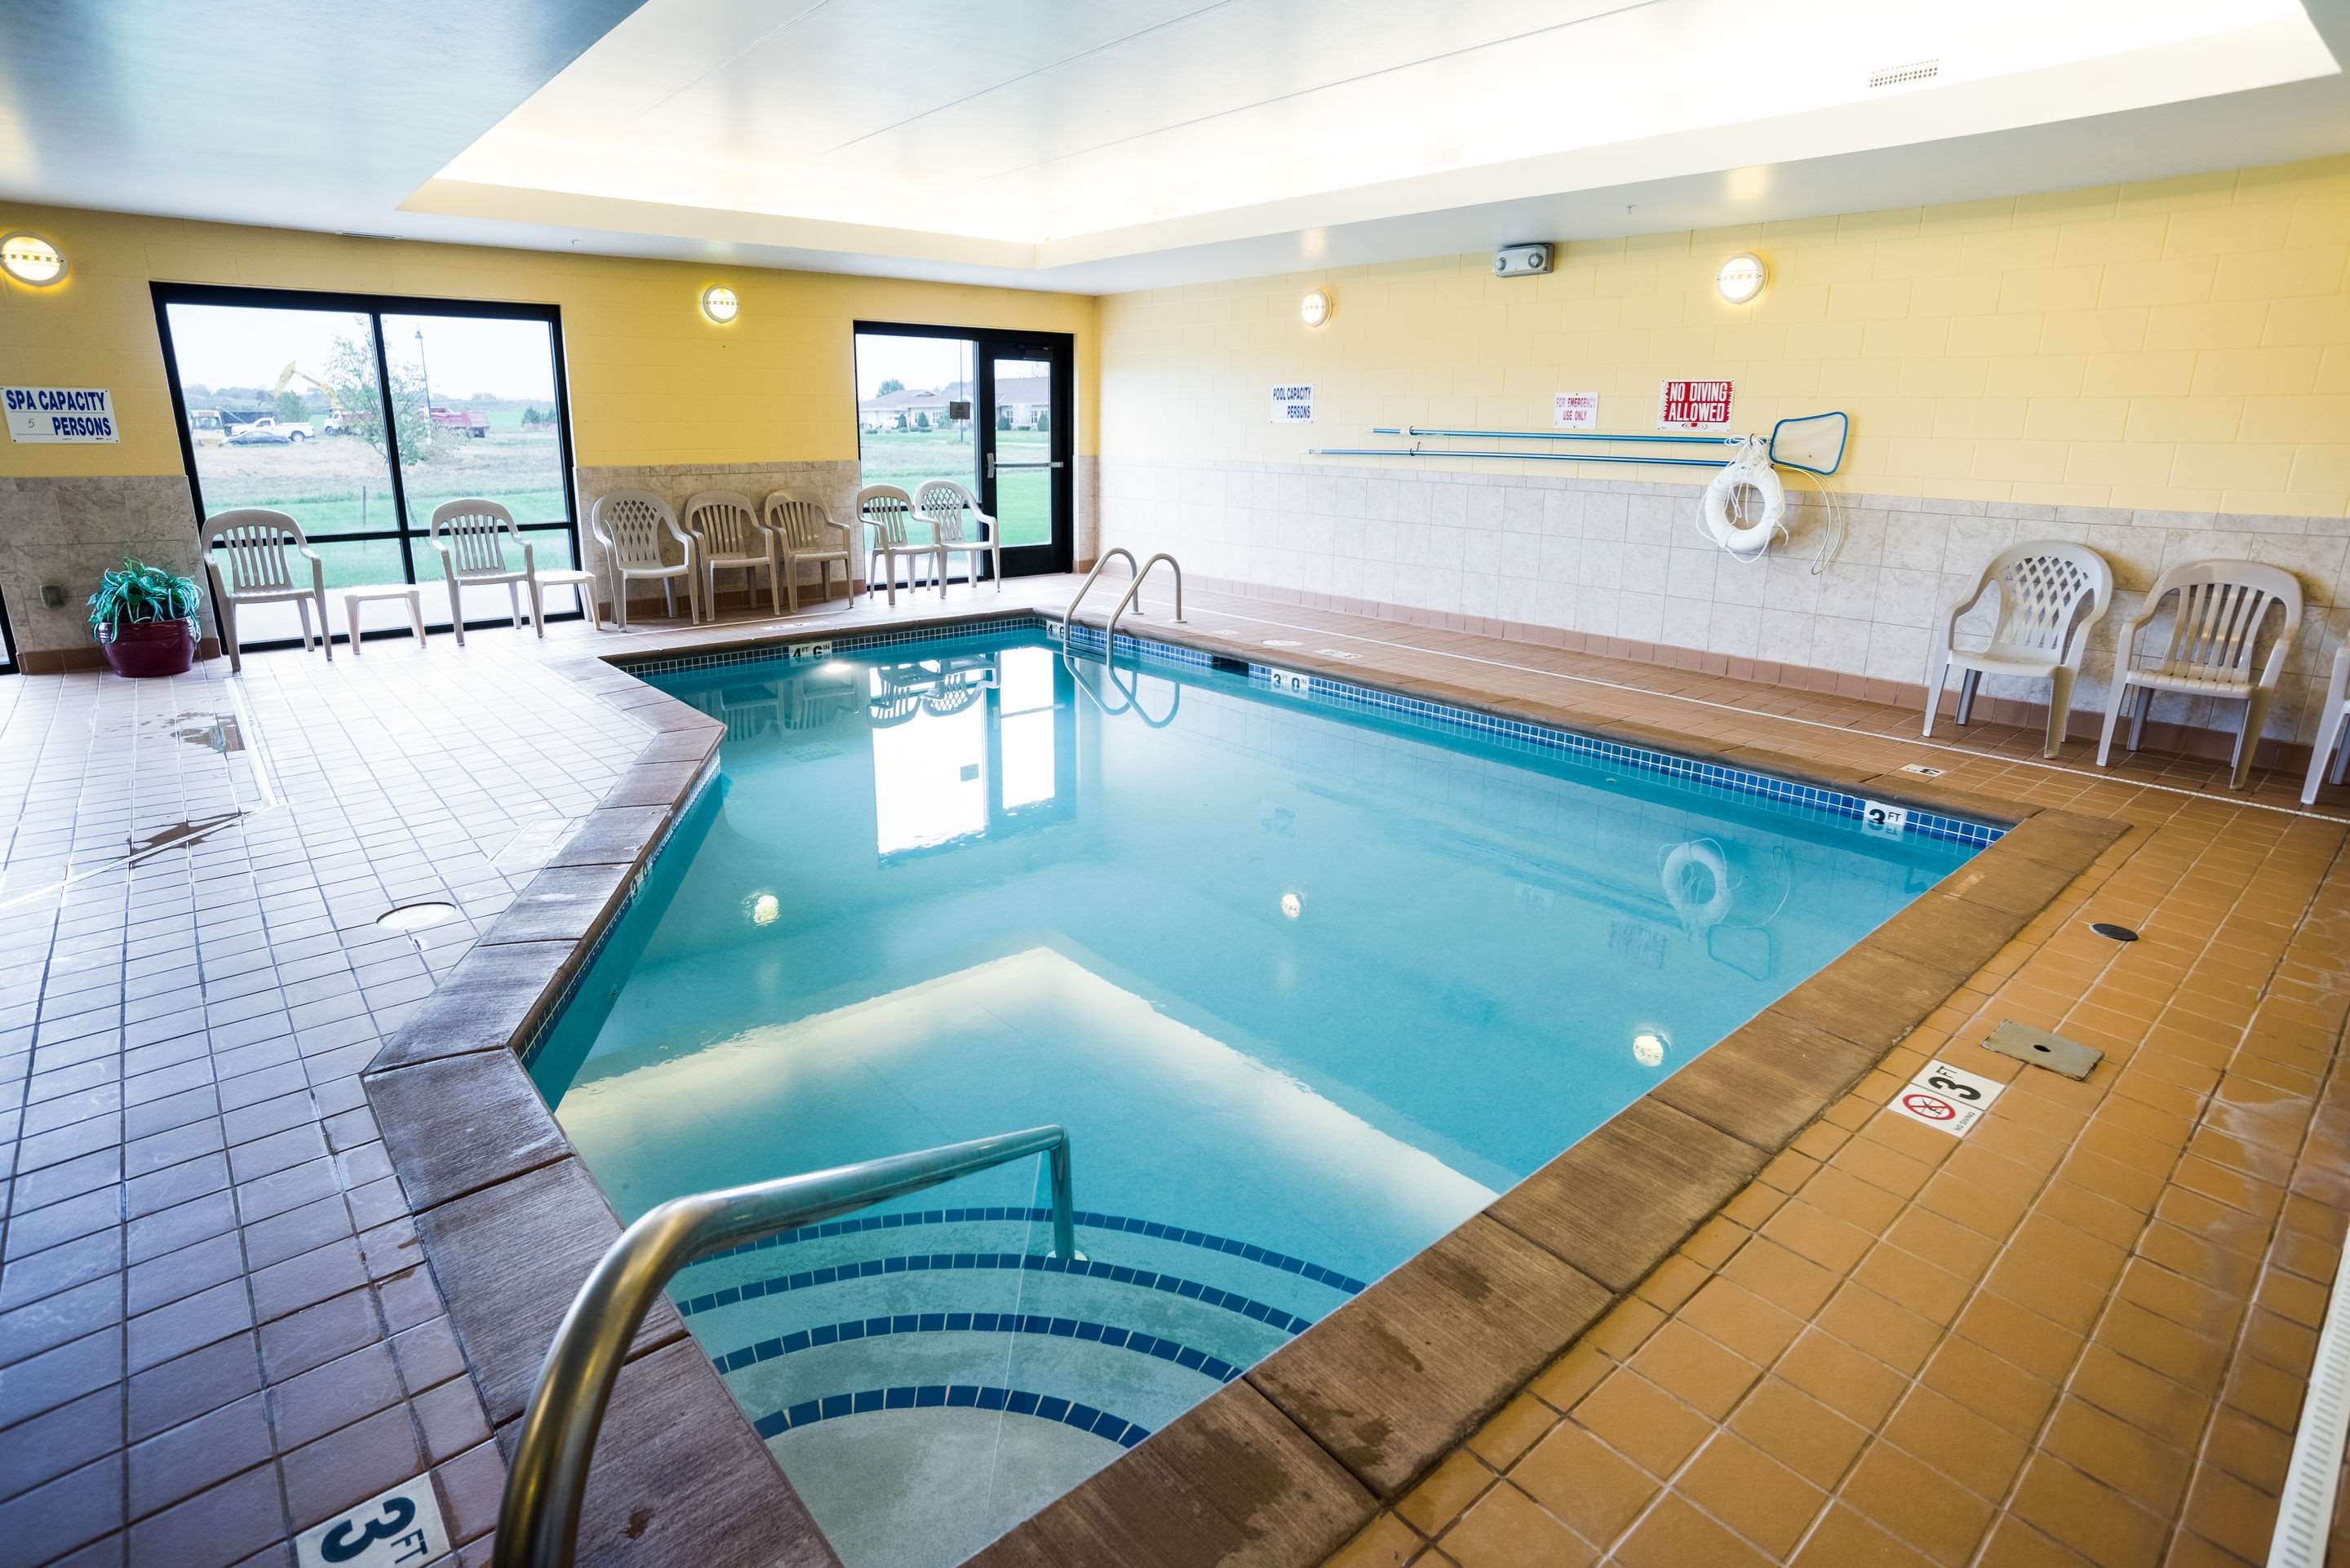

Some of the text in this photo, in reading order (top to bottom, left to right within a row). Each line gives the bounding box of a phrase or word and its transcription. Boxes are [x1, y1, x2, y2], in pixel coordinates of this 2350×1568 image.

[6, 390, 105, 411] SPA CAPACITY
[1273, 388, 1311, 401] POOL CAPACITY
[1669, 383, 1727, 402] NO DIVING
[1287, 405, 1310, 419] PERSONS
[1563, 410, 1587, 421] USE ONLY
[1668, 402, 1725, 422] ALLOWED
[52, 417, 112, 436] PERSONS
[1274, 674, 1281, 686] 3
[1869, 808, 1901, 826] 3 FT
[1928, 1065, 1981, 1101] 3 FT
[321, 1496, 428, 1565] 3 FT
